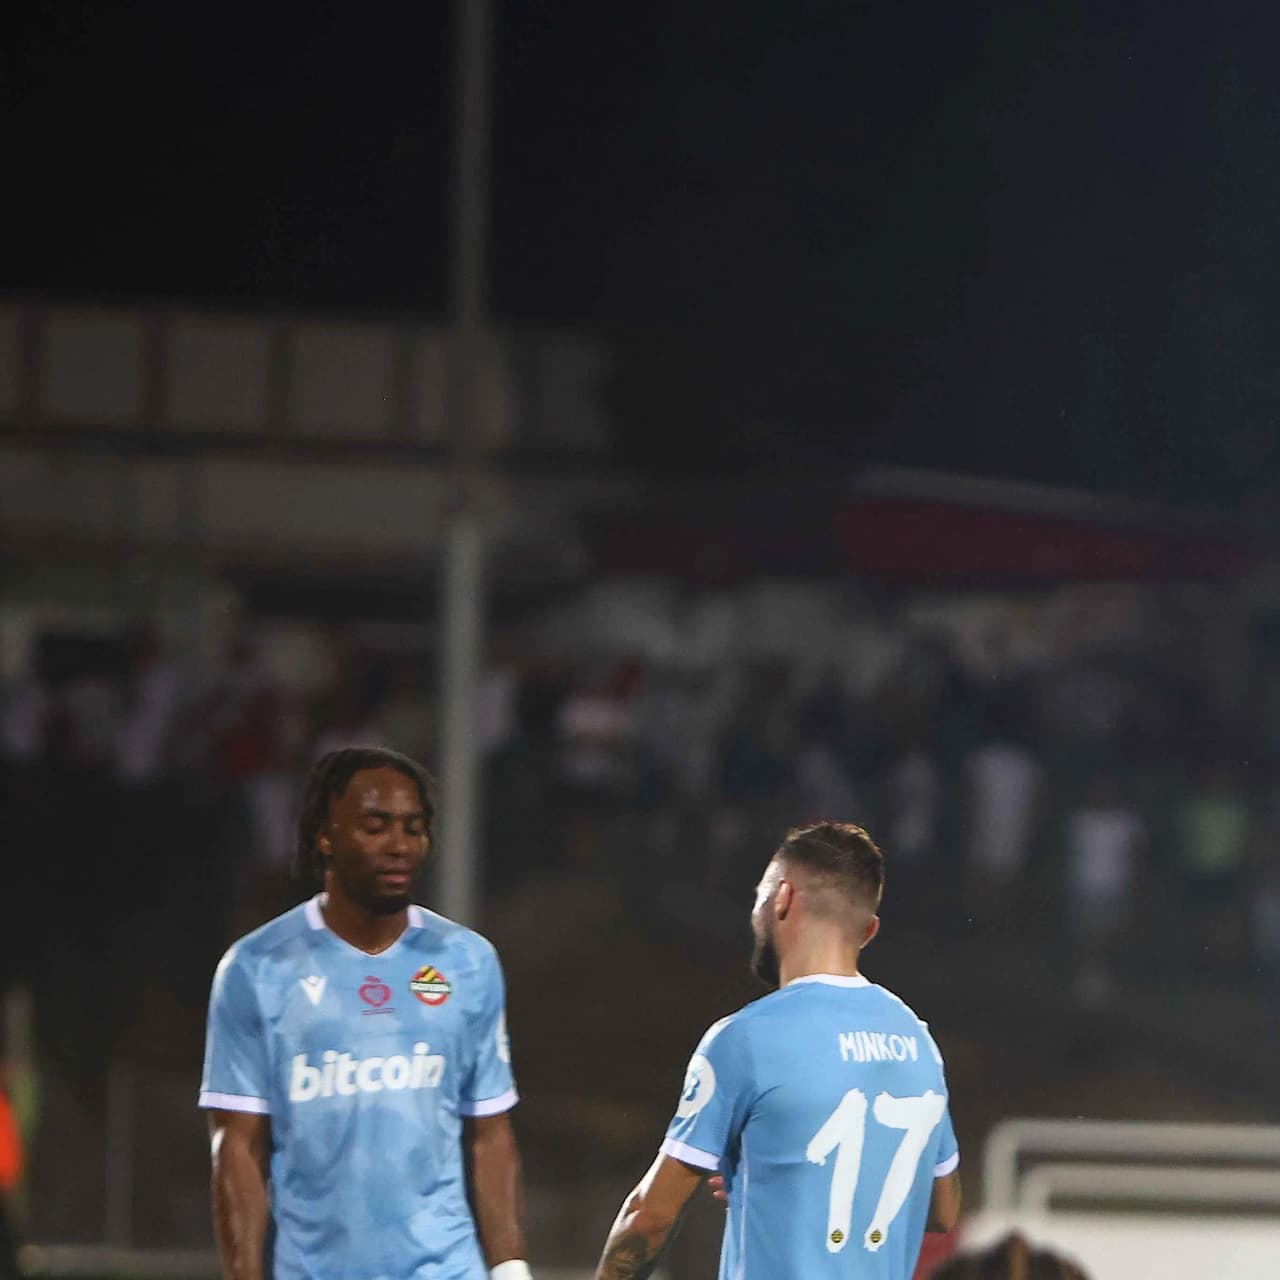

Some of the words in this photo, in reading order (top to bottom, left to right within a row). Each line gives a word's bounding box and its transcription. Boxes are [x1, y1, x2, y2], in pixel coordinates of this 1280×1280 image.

[290, 1042, 446, 1102] bitcoin
[839, 1031, 918, 1062] MINKOV
[806, 1088, 946, 1253] 17
